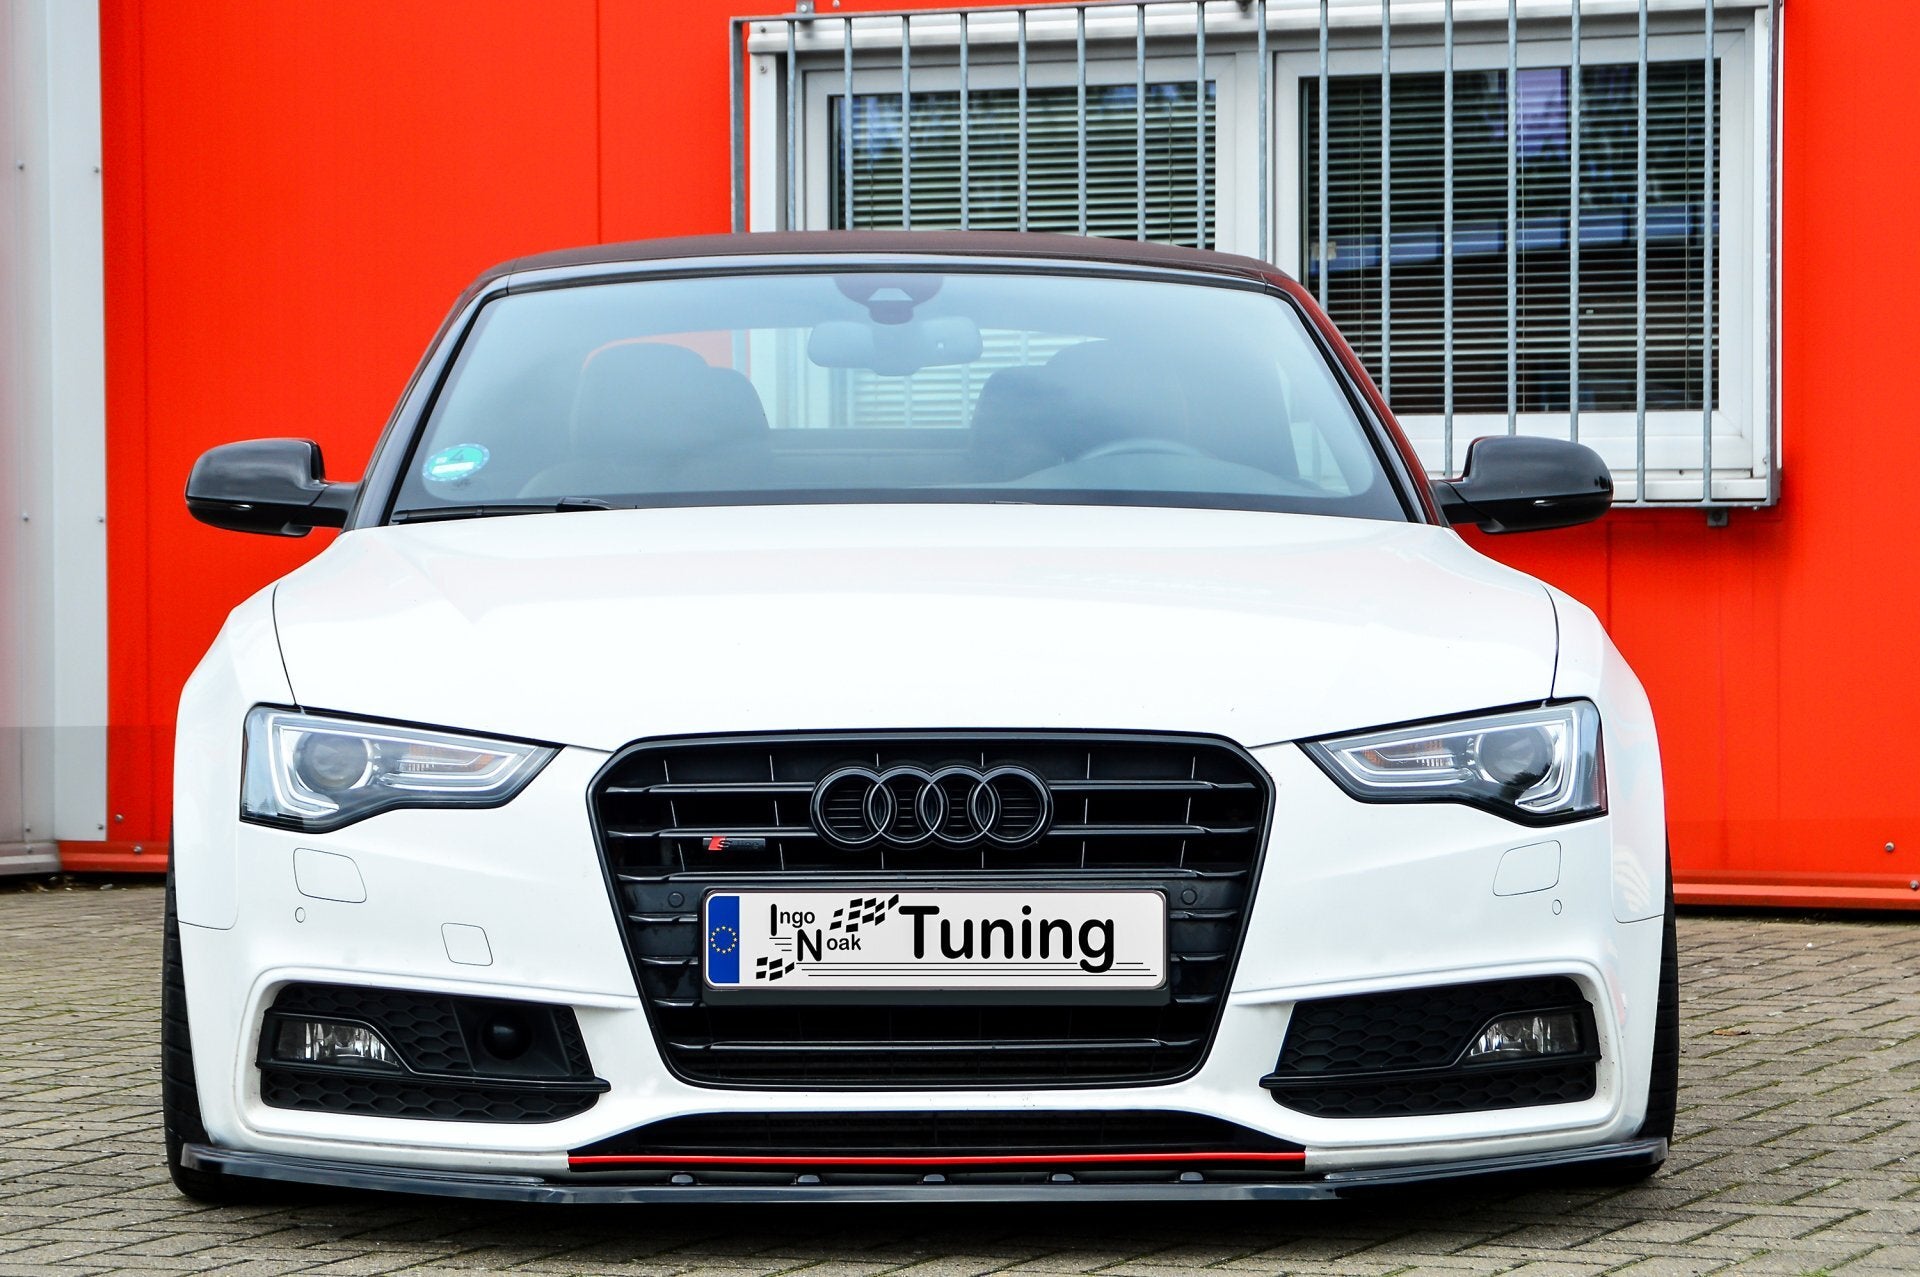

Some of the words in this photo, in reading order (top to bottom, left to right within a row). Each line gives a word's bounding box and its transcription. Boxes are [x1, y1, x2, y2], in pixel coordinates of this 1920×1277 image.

[769, 904, 816, 936] Ingo
[797, 929, 862, 961] Noak
[898, 904, 1115, 973] Tuning
